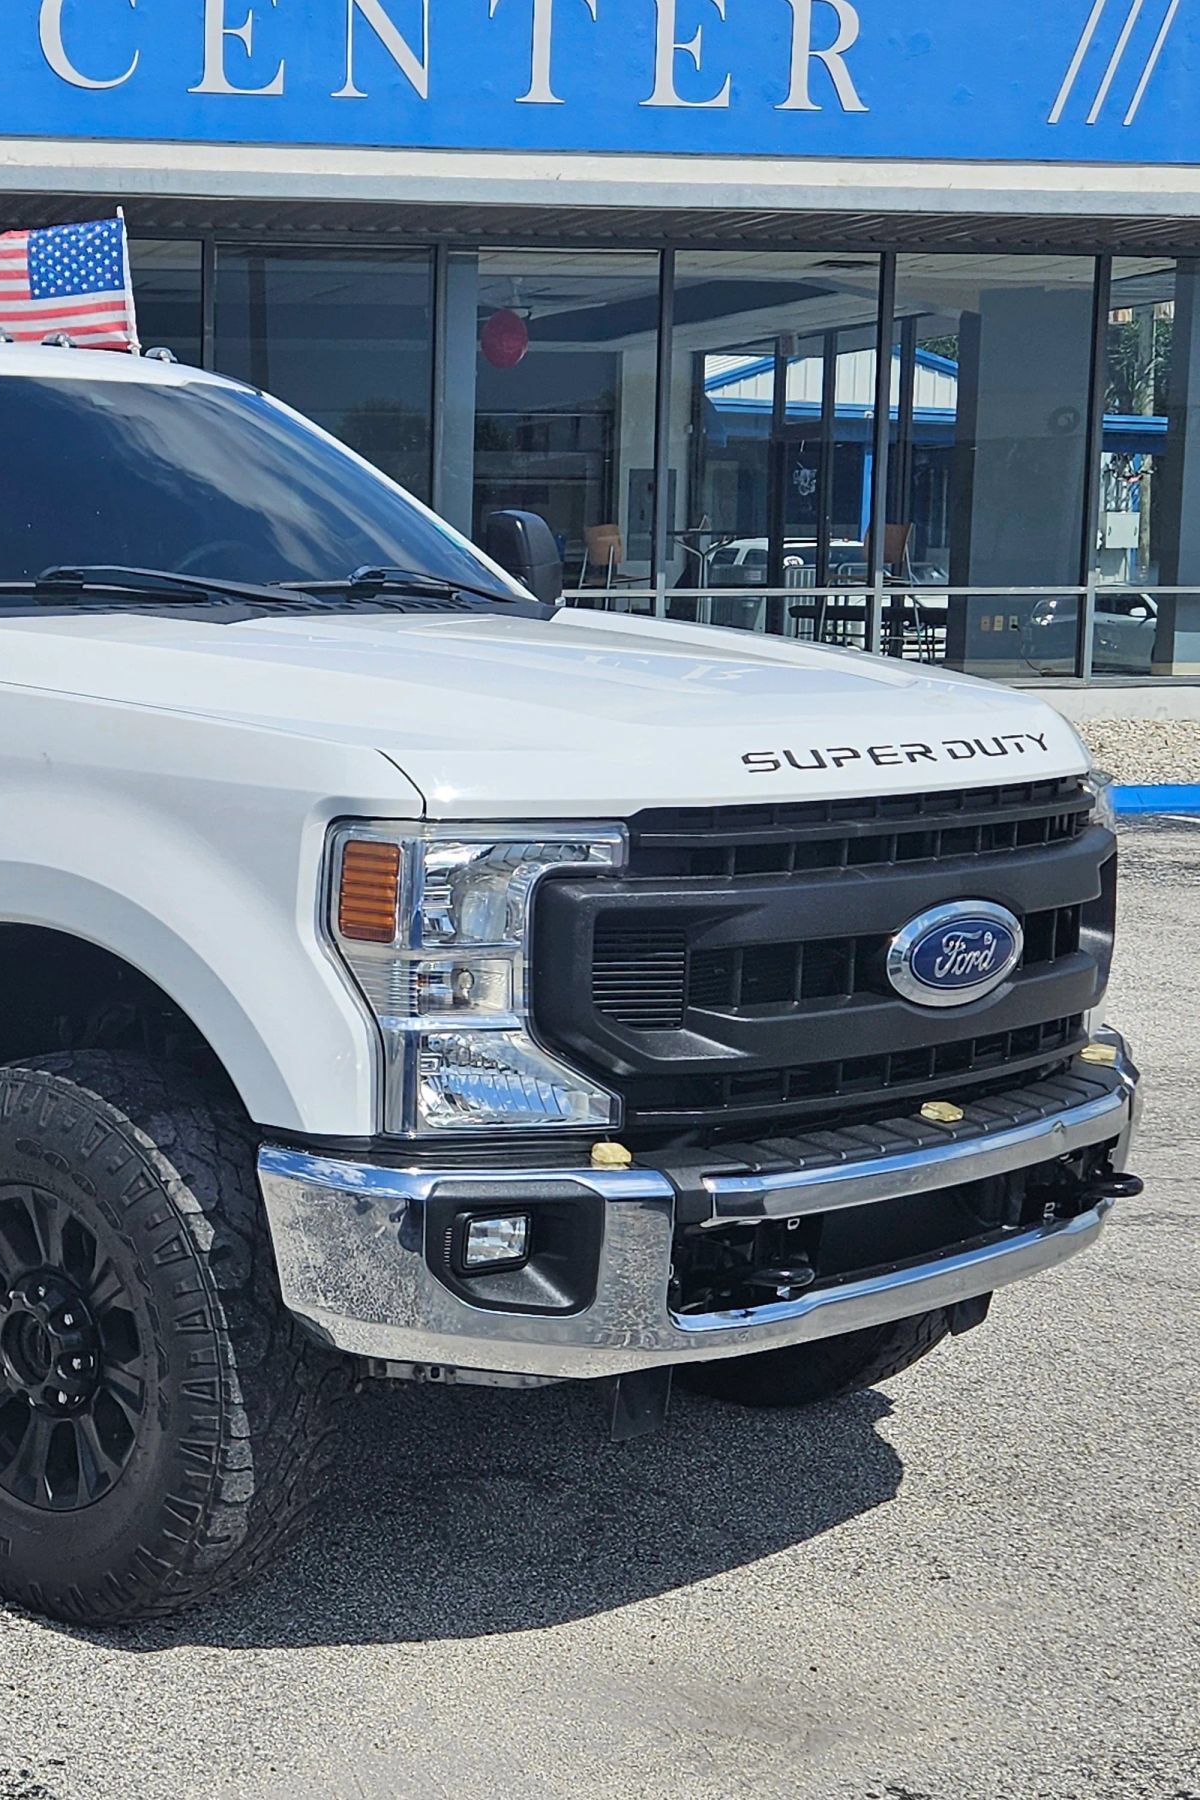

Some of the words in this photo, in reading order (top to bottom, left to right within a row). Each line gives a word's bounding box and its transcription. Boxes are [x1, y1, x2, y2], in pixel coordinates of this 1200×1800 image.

[36, 0, 871, 113] CENTER
[741, 743, 938, 773] SUPER
[942, 732, 1048, 760] DUTY
[934, 930, 998, 979] Ford
